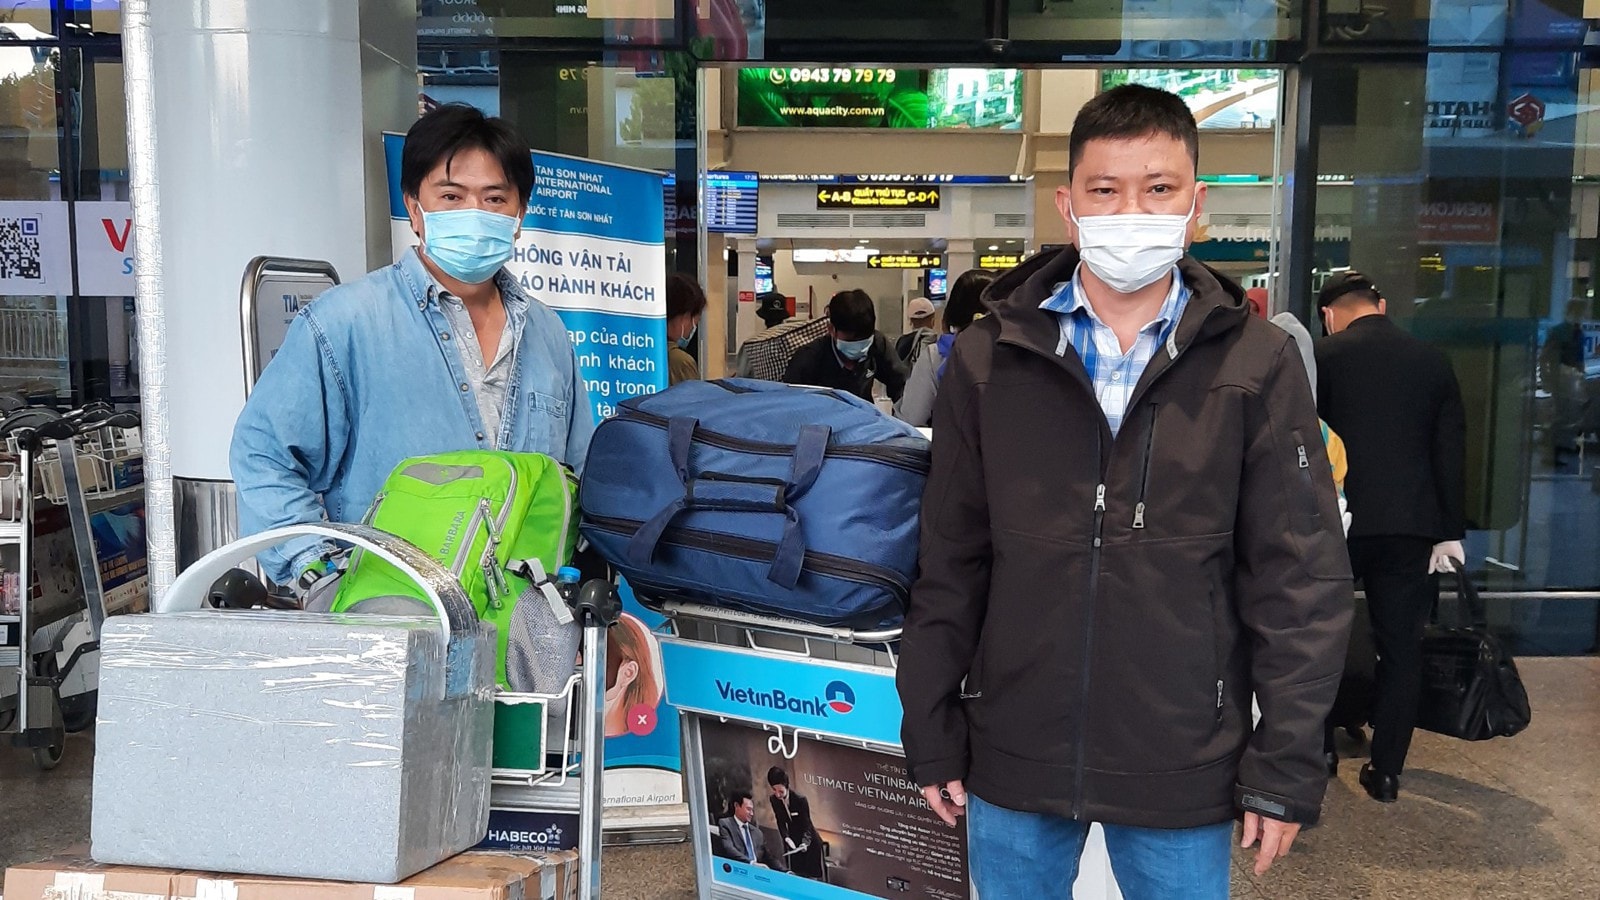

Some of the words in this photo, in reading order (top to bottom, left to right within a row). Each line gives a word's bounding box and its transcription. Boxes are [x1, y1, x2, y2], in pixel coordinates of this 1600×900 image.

[790, 68, 830, 83] 0943
[833, 69, 851, 83] 79
[855, 69, 873, 83] 79
[877, 69, 896, 83] 79
[779, 106, 885, 117] www.aquacity.com.vn
[535, 165, 553, 176] TAN
[556, 168, 577, 179] SON
[579, 172, 603, 183] NHAT
[535, 175, 613, 195] INTERNATIONAL
[536, 187, 578, 200] AIRPORT
[830, 191, 851, 202] A-B
[907, 191, 926, 203] C-D
[514, 243, 563, 266] HÔNG
[569, 249, 602, 271] VẬN
[606, 252, 632, 273] TẢI
[519, 271, 544, 291] ÁO
[549, 274, 595, 295] HÀNH
[600, 280, 655, 301] KHÁCH
[282, 294, 299, 313] TIA
[590, 327, 618, 344] của
[622, 331, 654, 350] dịch
[579, 353, 600, 367] nh
[609, 353, 655, 372] khách
[715, 679, 829, 718] VietinBank
[863, 771, 923, 794] VIETINBAN
[647, 793, 676, 804] Airport
[804, 773, 855, 794] ULTIMATE
[857, 785, 906, 804] VIETNAM
[908, 795, 934, 812] AIRL
[488, 830, 548, 844] HABECO
